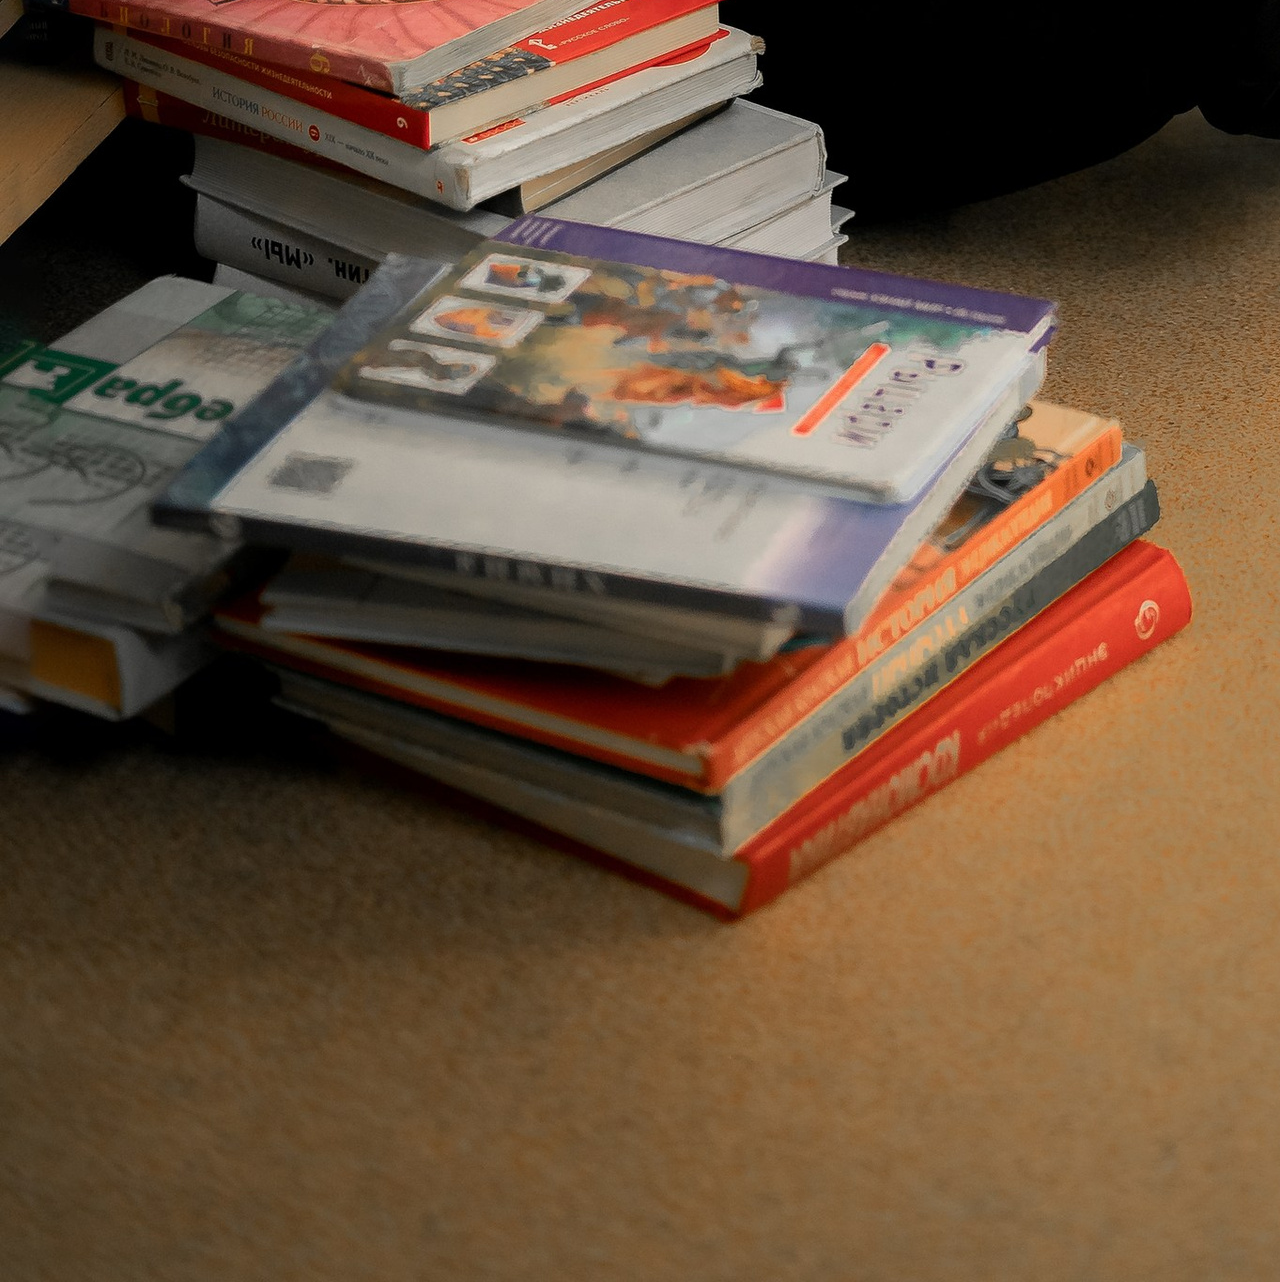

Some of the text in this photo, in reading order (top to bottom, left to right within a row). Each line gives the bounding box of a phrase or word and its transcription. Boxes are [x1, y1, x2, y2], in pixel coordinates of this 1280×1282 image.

[209, 46, 261, 73] БЕЗОПАСНОСТИ
[259, 65, 333, 101] ЖИЗНЕДЕЯТЕЛЬНОСТИ
[211, 86, 260, 116] ИСТОРИЯ
[260, 106, 304, 134] РОССИИ
